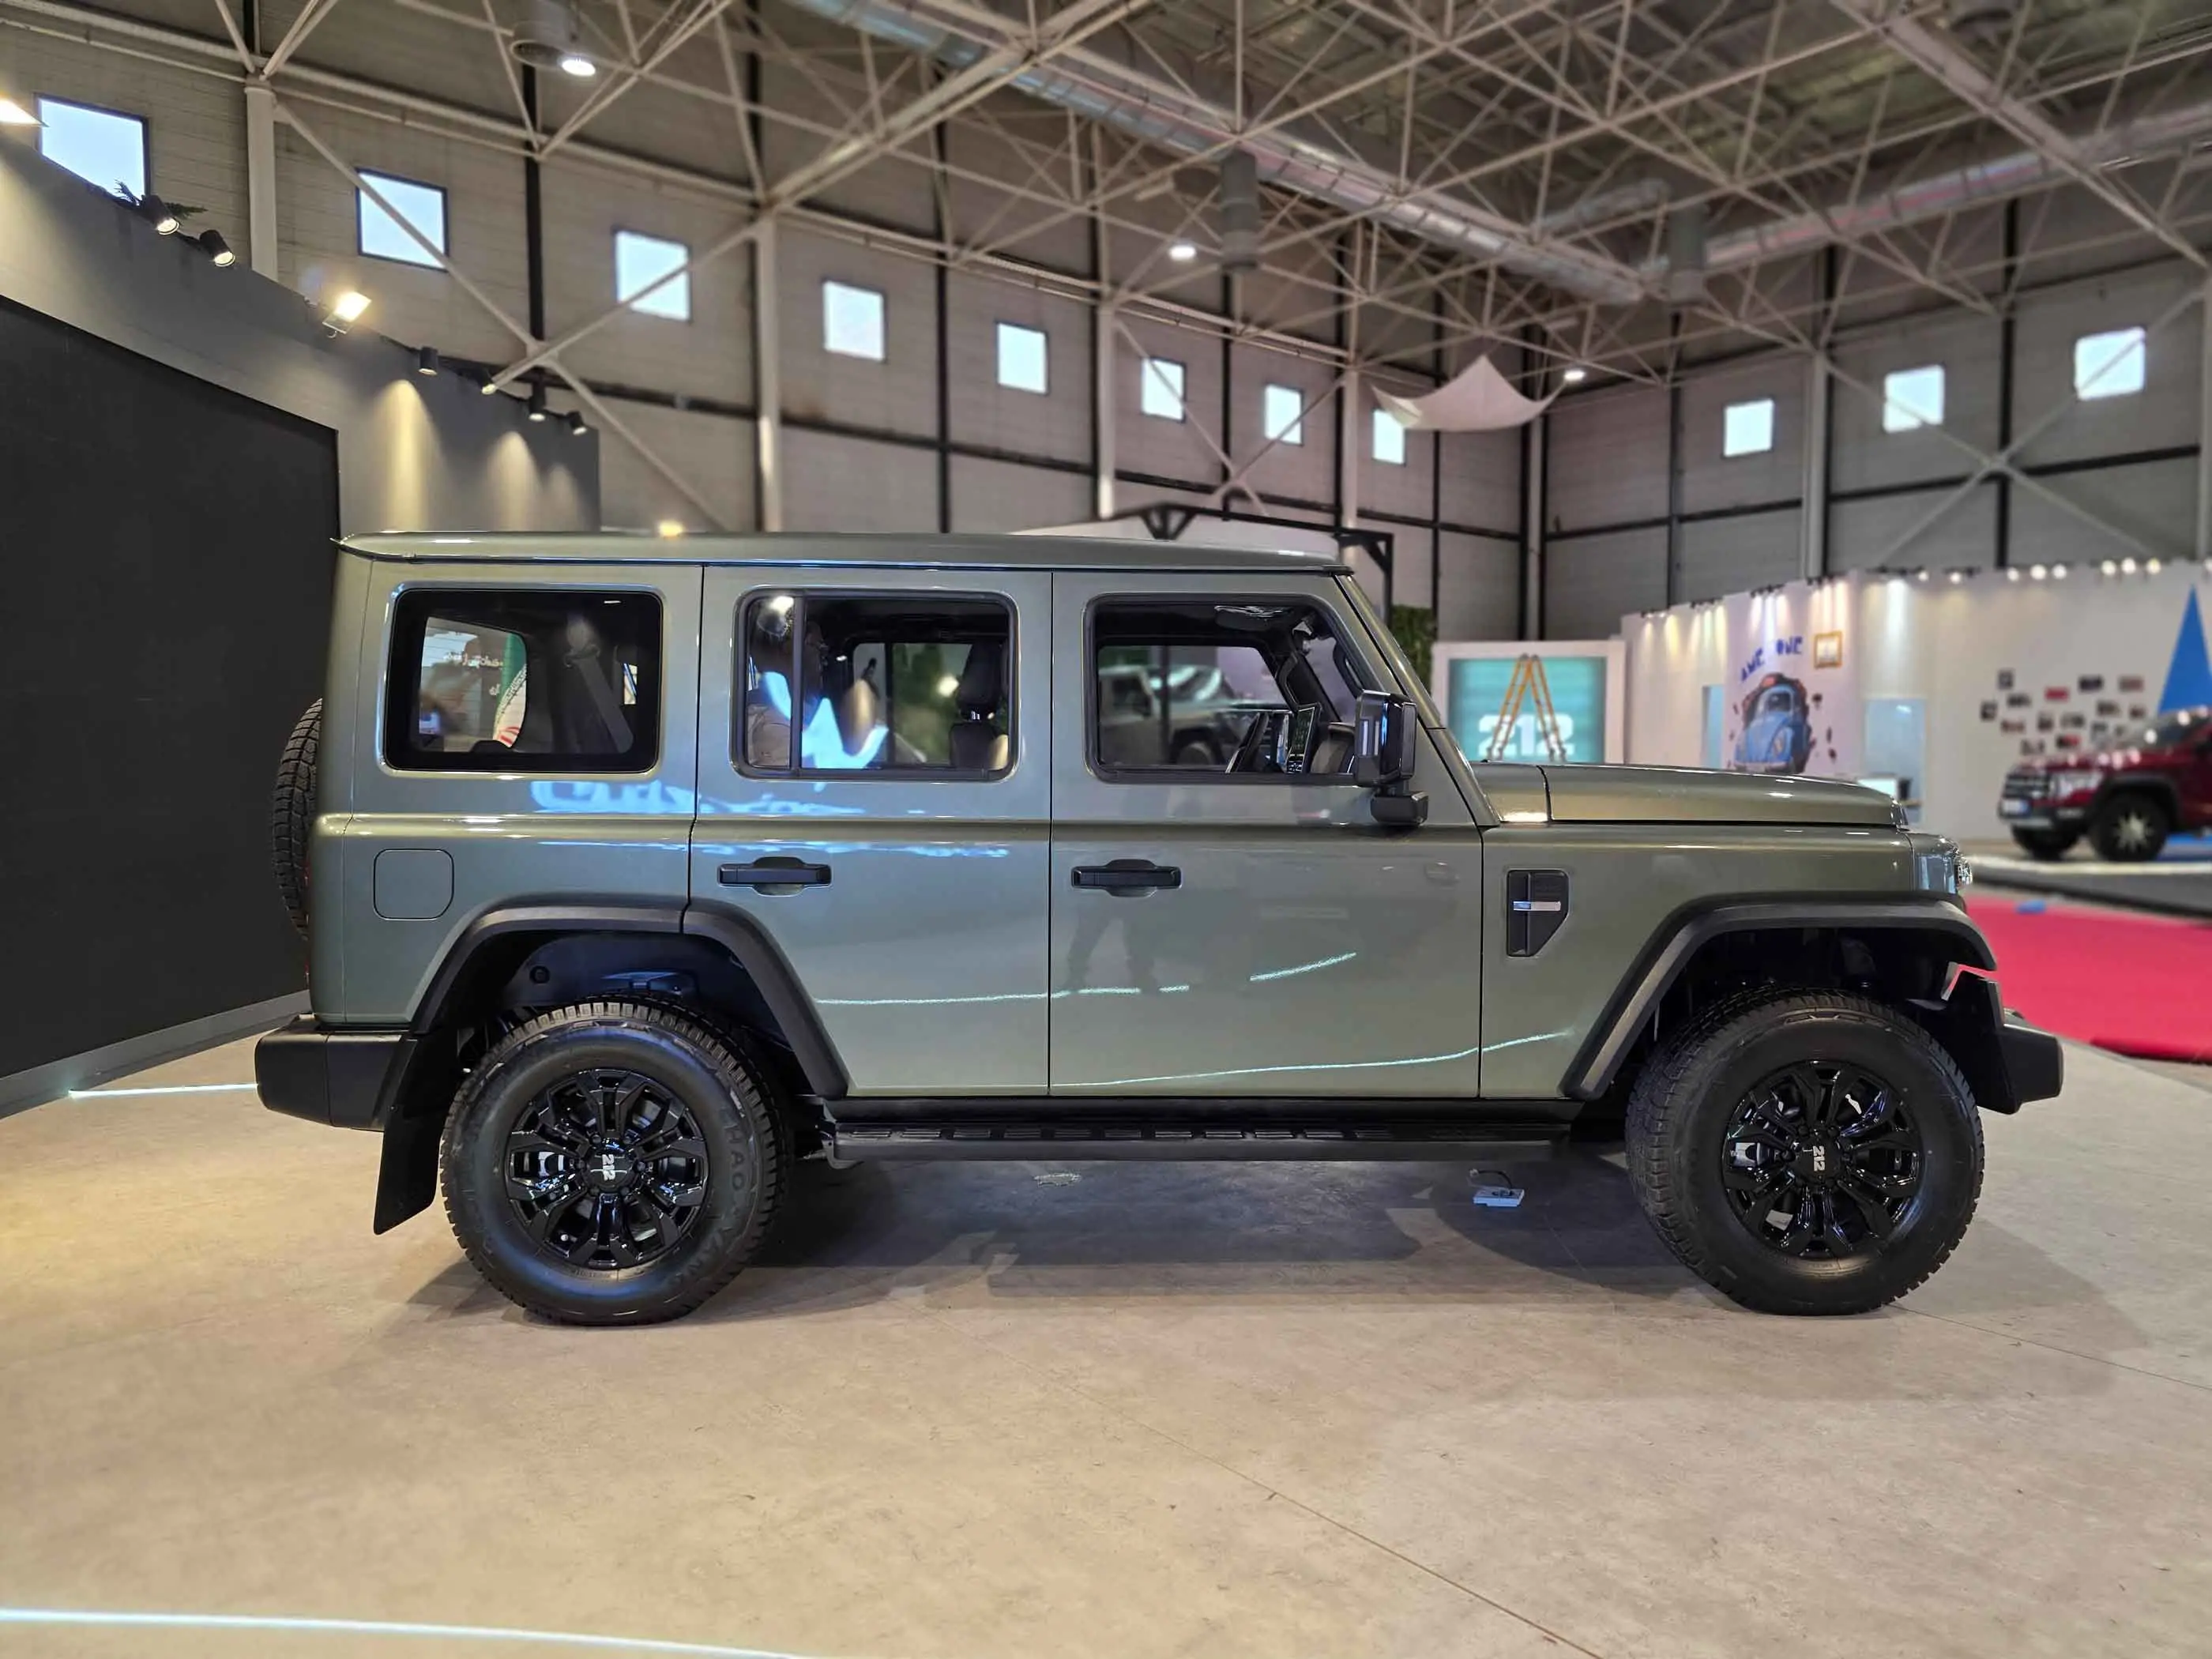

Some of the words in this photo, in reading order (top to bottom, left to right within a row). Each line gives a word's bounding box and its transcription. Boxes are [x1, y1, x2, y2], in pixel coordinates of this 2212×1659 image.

[1478, 714, 1576, 757] 212
[602, 1153, 616, 1181] 212
[1812, 1146, 1826, 1172] 212
